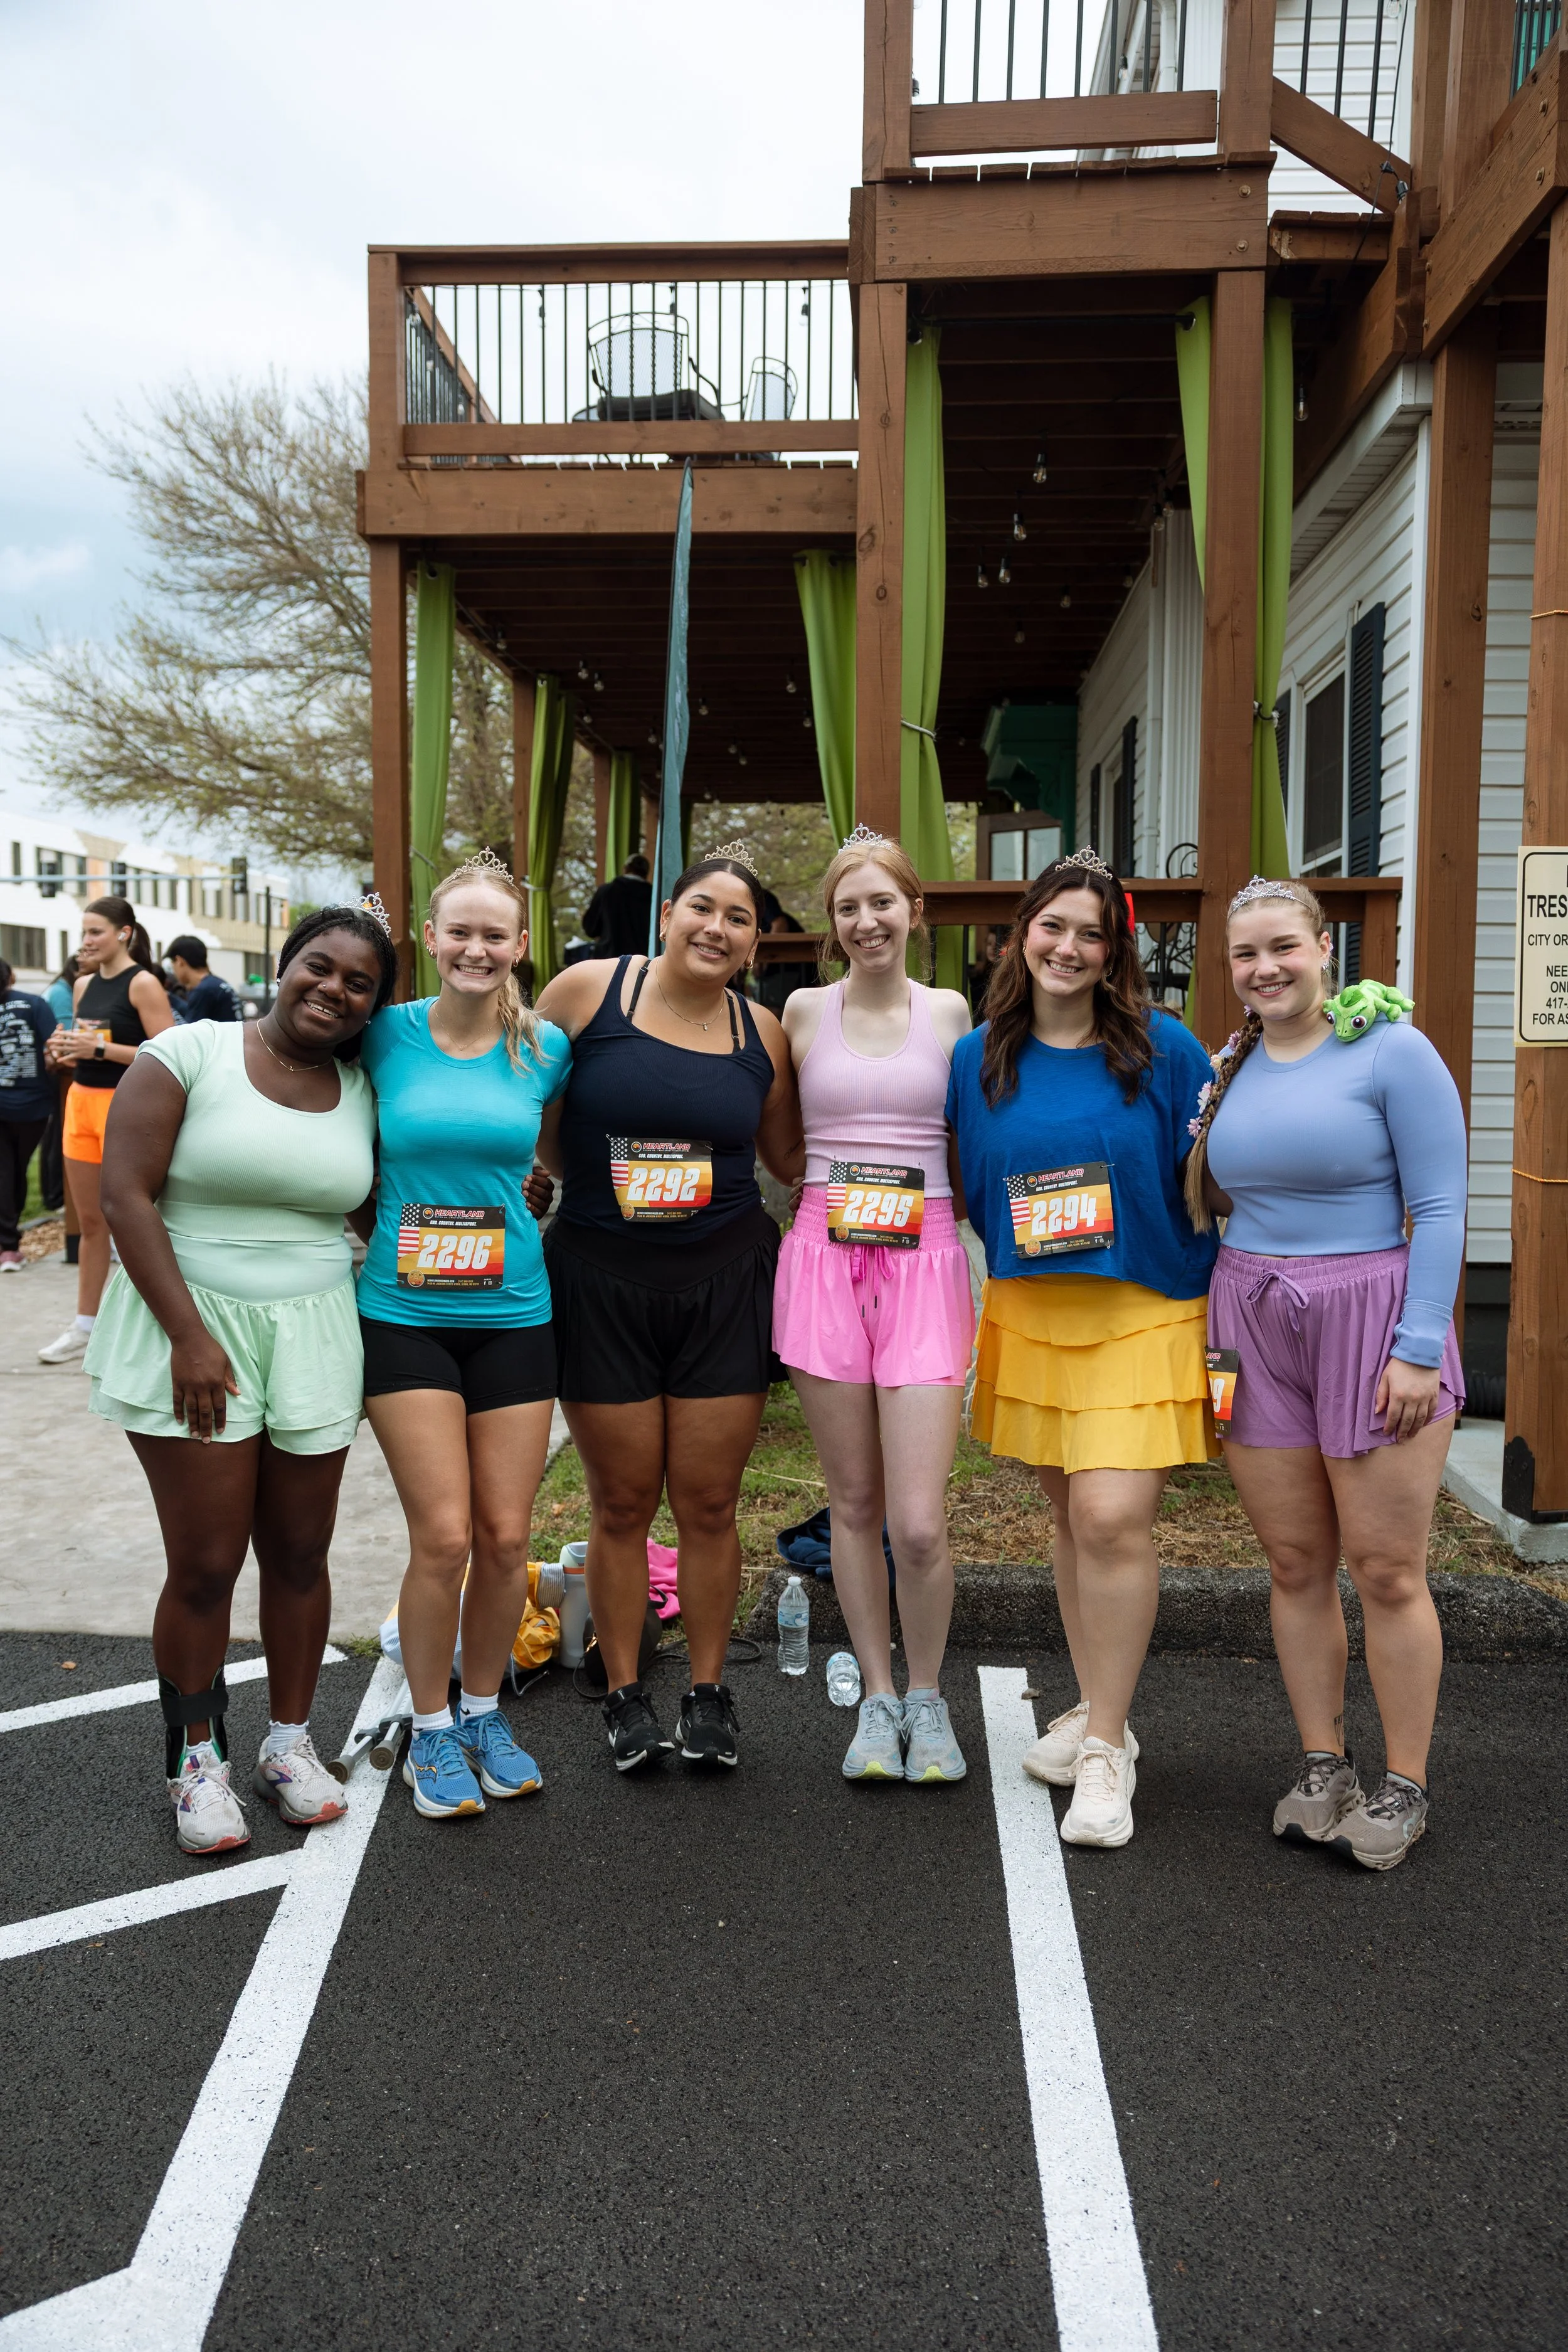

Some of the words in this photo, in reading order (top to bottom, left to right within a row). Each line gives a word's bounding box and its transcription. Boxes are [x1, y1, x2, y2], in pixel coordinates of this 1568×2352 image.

[1527, 894, 1567, 918] TRES
[1528, 934, 1550, 946] CITY
[1554, 934, 1568, 946] OR
[1547, 965, 1568, 977] NEE
[1550, 981, 1568, 993] ON
[1546, 997, 1568, 1009] 417-
[1533, 1013, 1555, 1025] FOR
[861, 1167, 908, 1177] HEARTLAND
[1038, 1168, 1084, 1182] HEARTLAND
[627, 1167, 701, 1202] 2292
[842, 1190, 914, 1227] 2295
[1031, 1193, 1097, 1236] 2294
[416, 1234, 492, 1269] 2296
